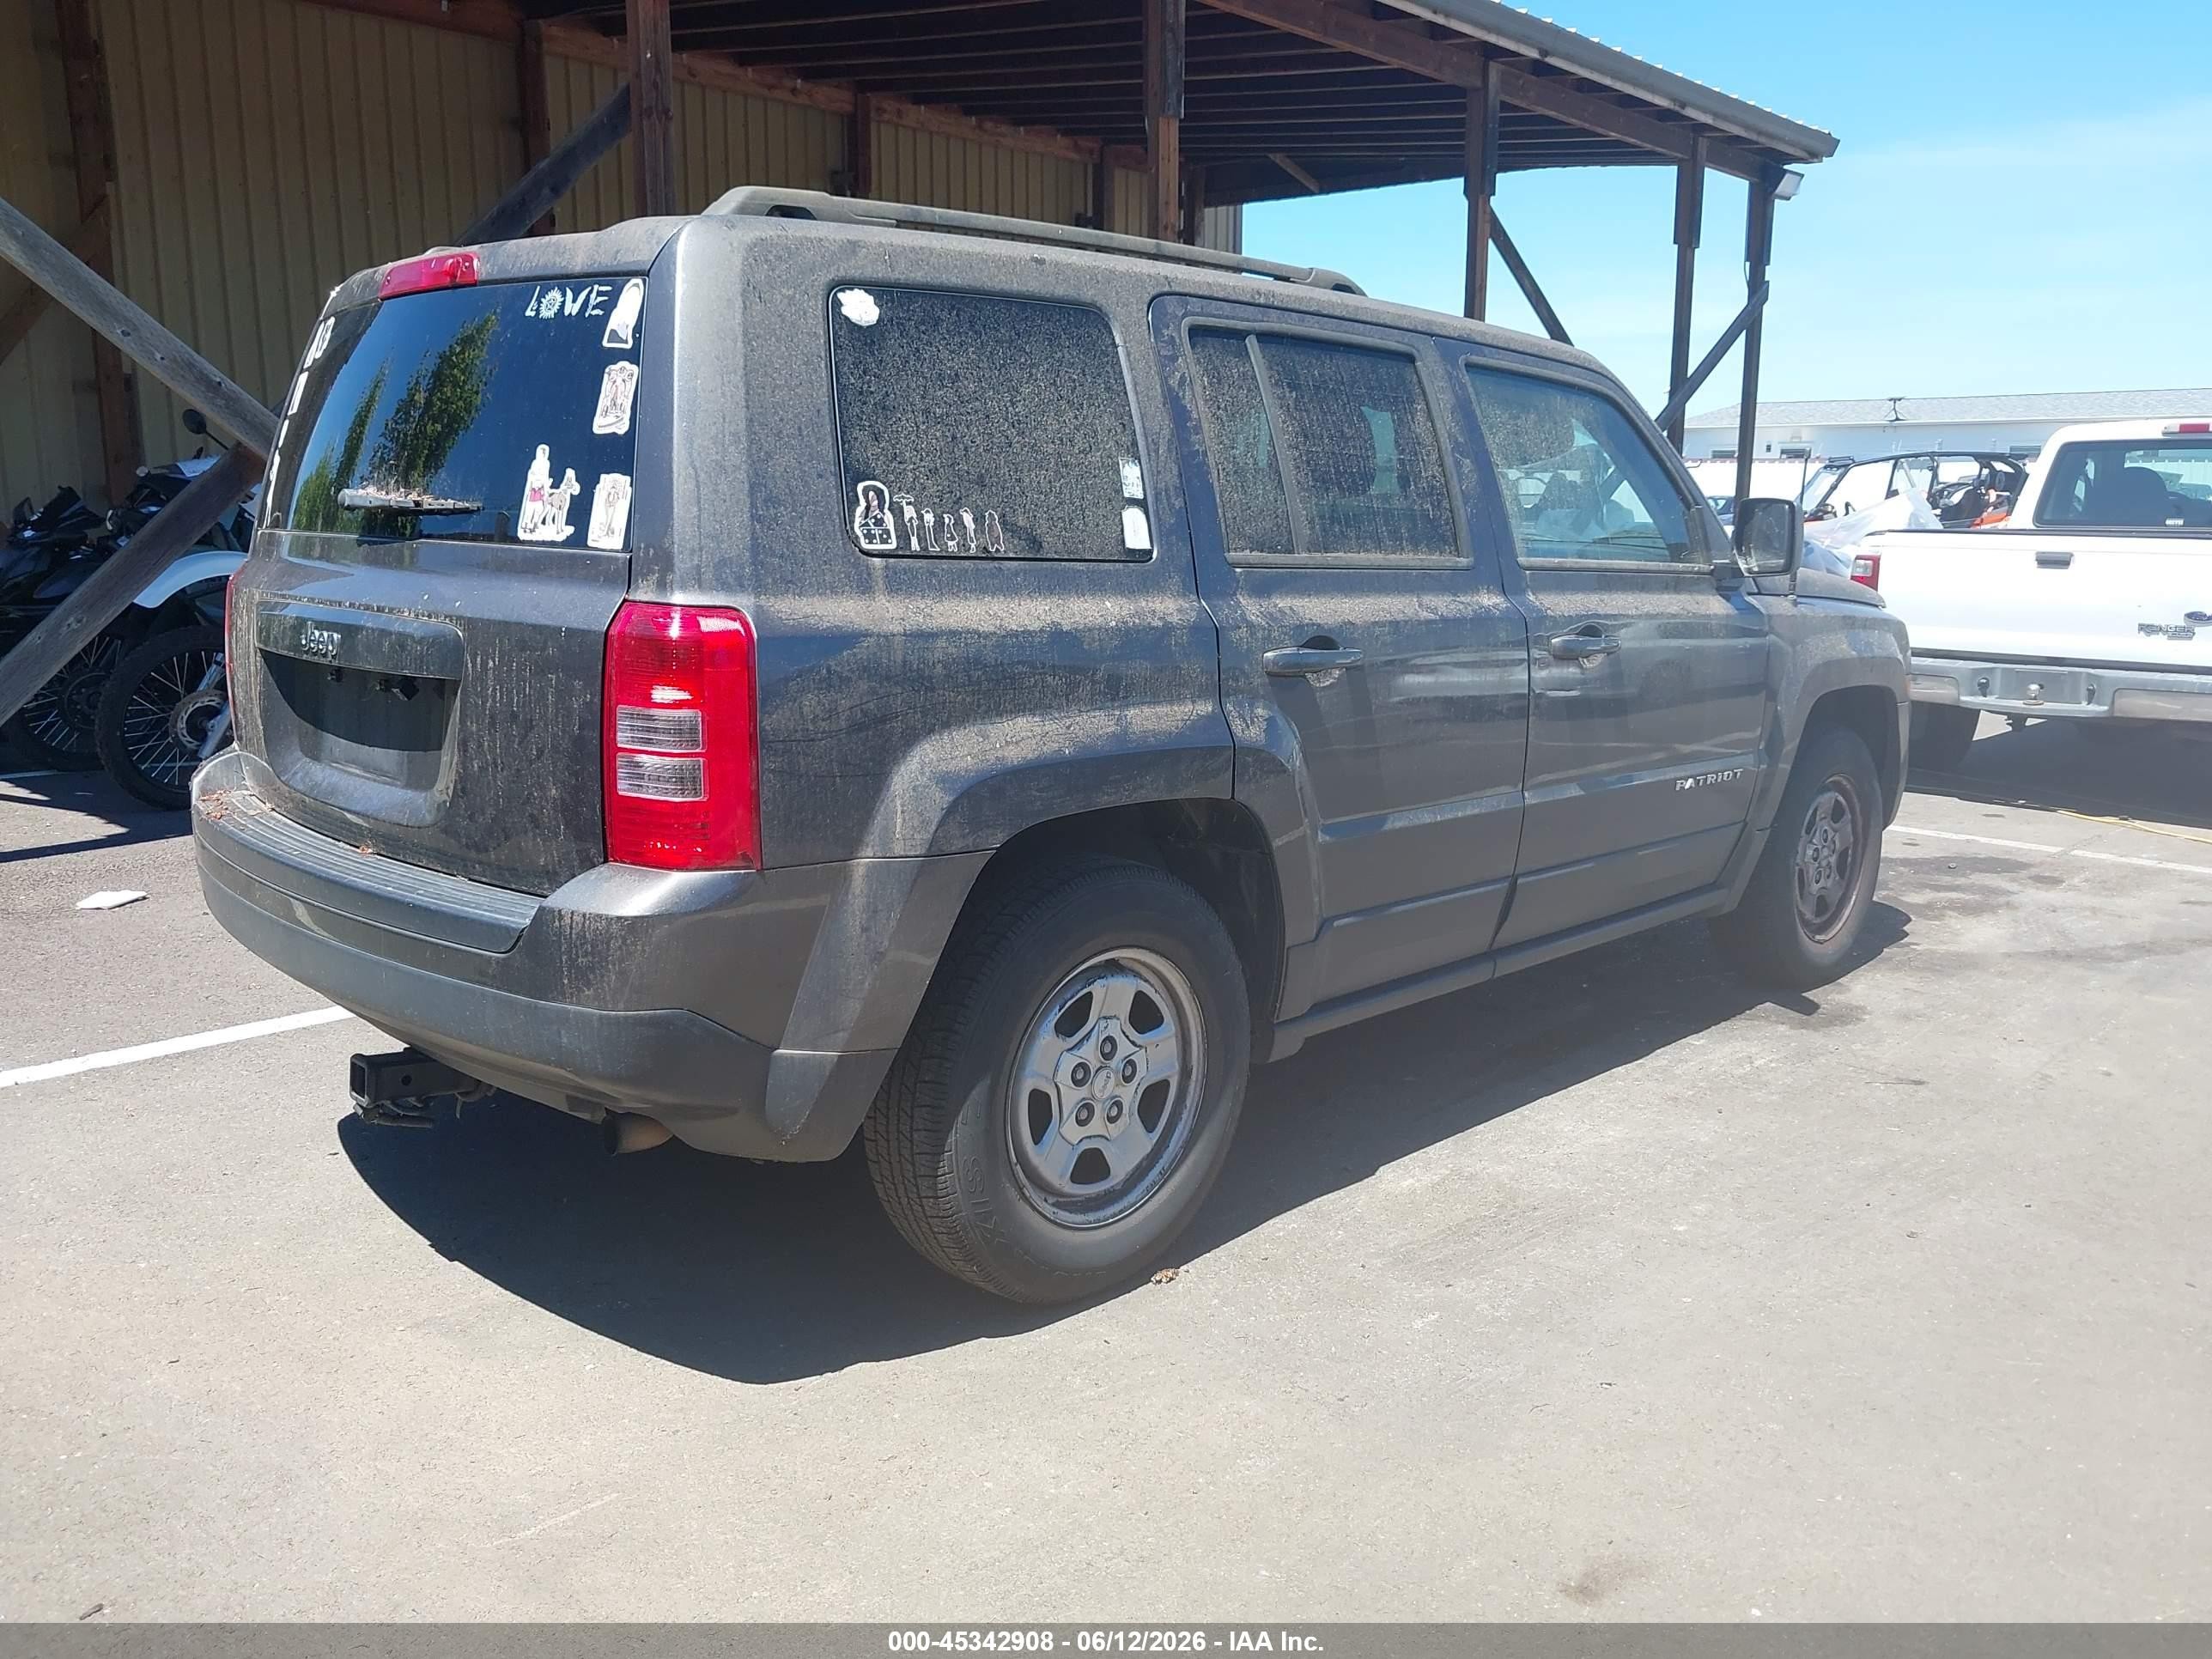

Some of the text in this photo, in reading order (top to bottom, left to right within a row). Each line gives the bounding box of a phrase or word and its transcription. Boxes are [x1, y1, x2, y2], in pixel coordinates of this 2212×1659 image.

[525, 284, 613, 319] LOVE
[300, 621, 342, 659] Jeep
[1675, 769, 1744, 791] PATRIOT
